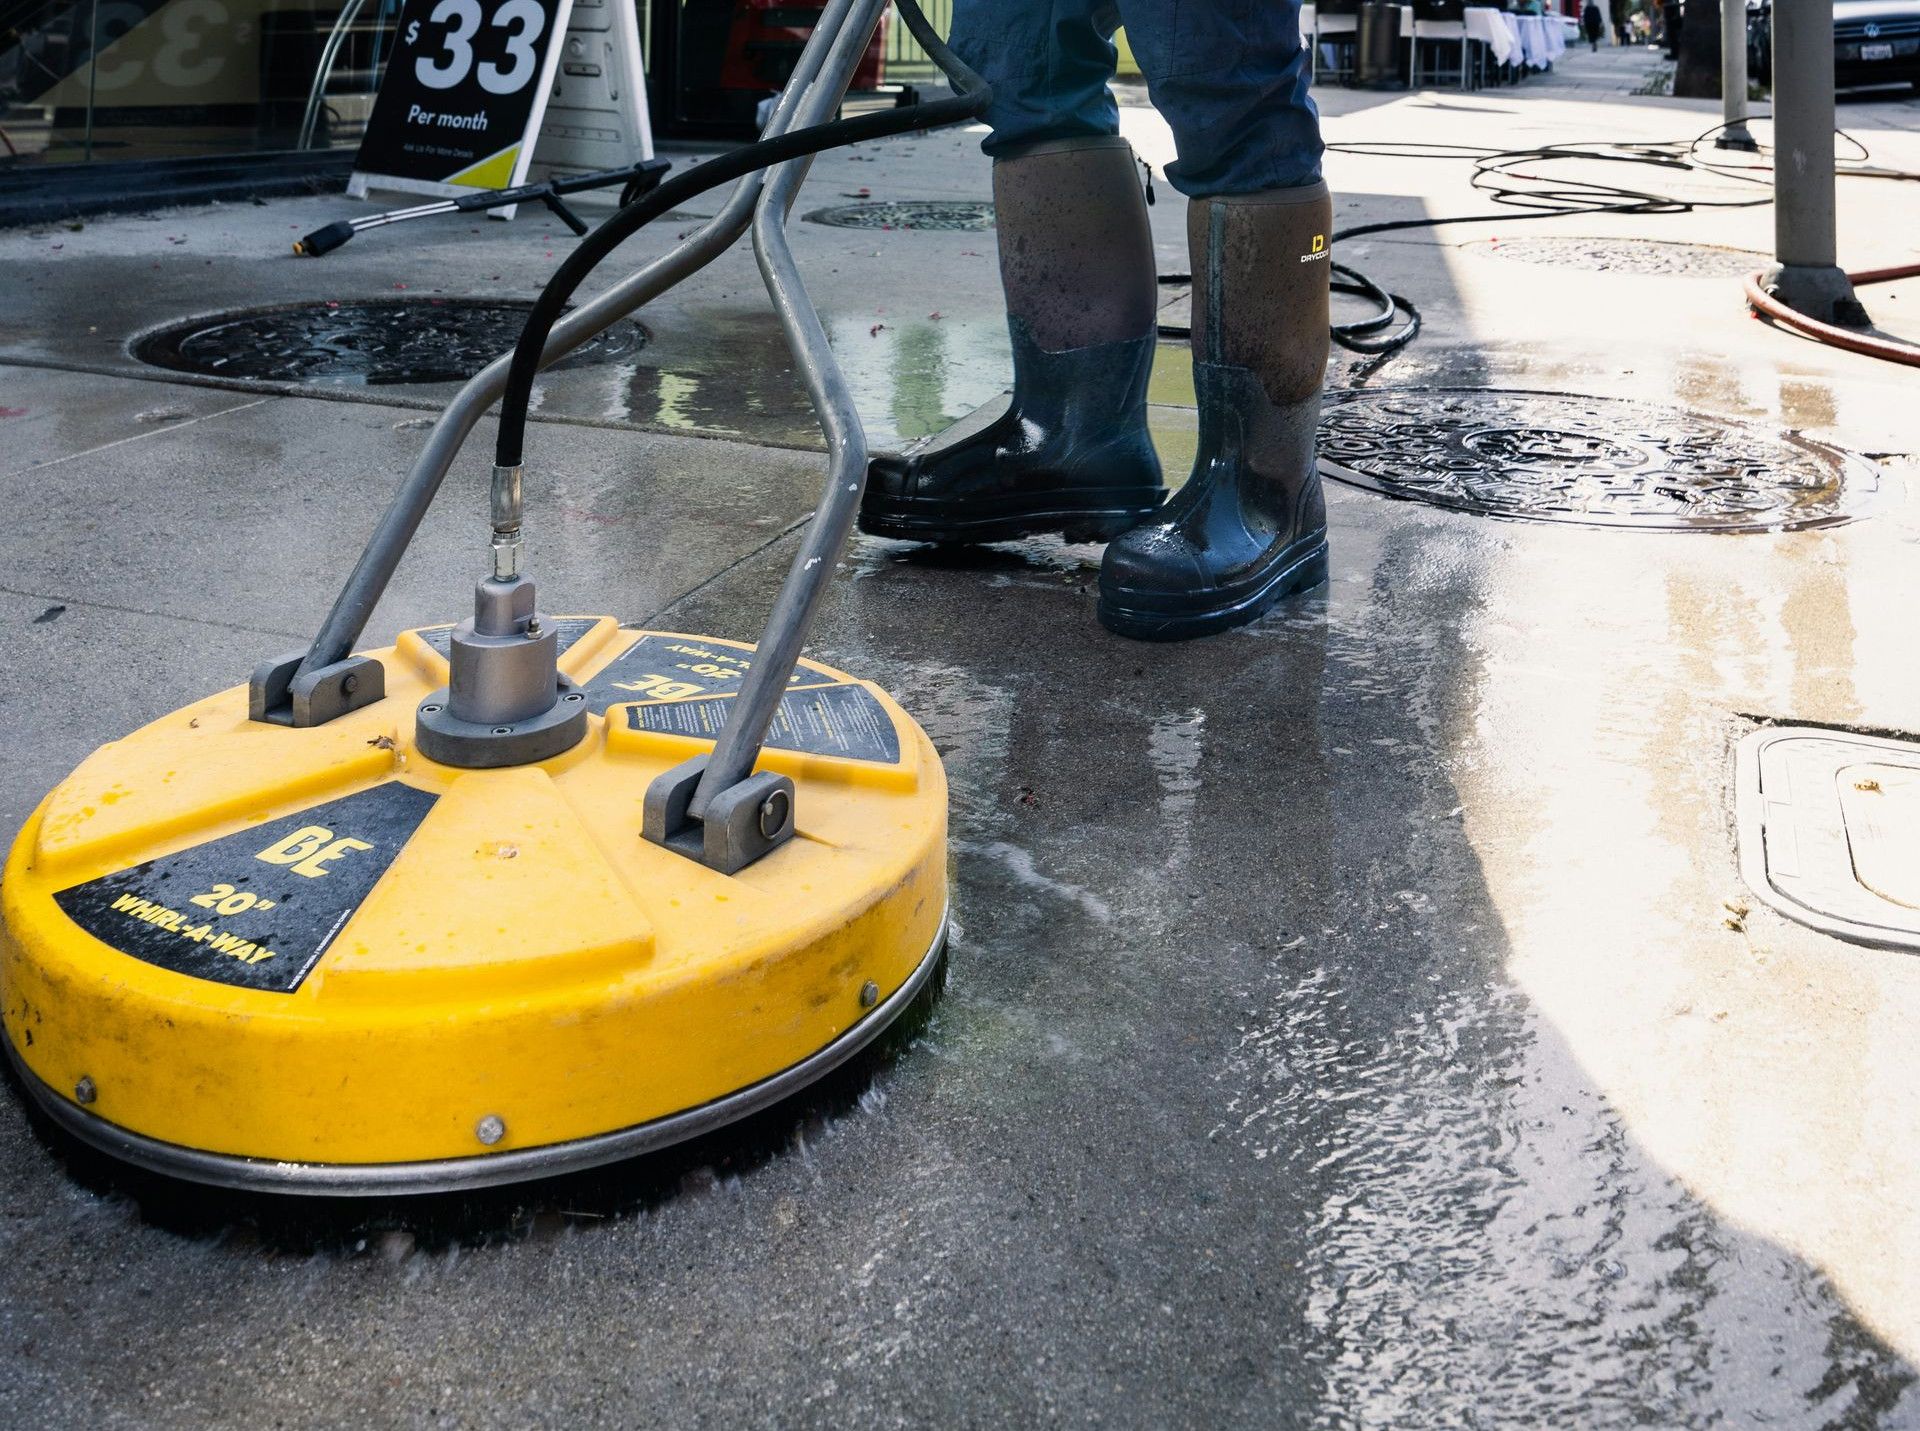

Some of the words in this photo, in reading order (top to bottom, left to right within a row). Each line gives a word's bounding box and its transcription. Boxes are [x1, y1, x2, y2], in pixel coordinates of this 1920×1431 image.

[408, 104, 435, 125] Per
[437, 111, 488, 131] month
[254, 825, 374, 879] BE
[109, 893, 277, 965] WHIRL-A-WAY
